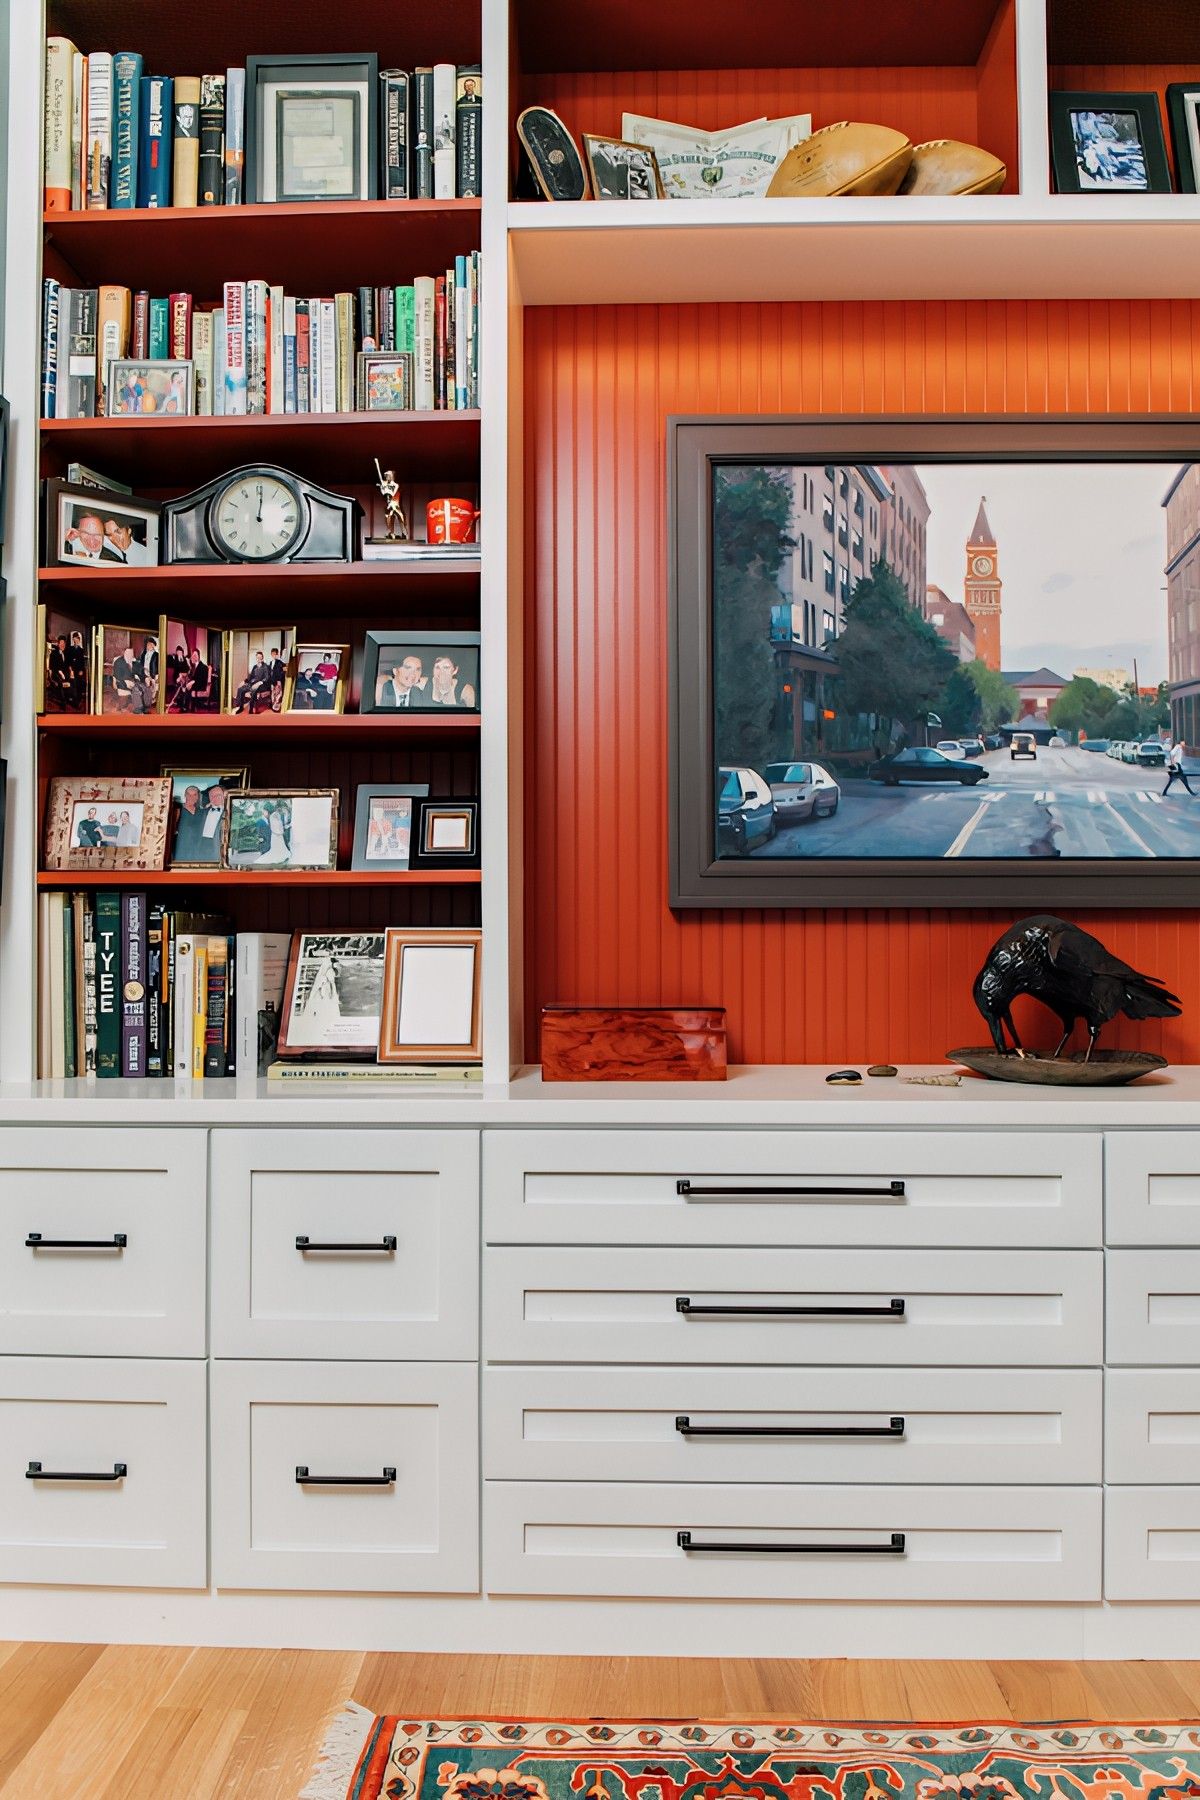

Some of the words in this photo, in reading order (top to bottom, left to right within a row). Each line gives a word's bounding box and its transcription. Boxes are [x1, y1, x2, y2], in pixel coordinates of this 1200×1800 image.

[117, 82, 132, 117] THE
[117, 120, 132, 164] CIVIL
[115, 165, 132, 202] WAR
[100, 932, 114, 1013] TYEE
